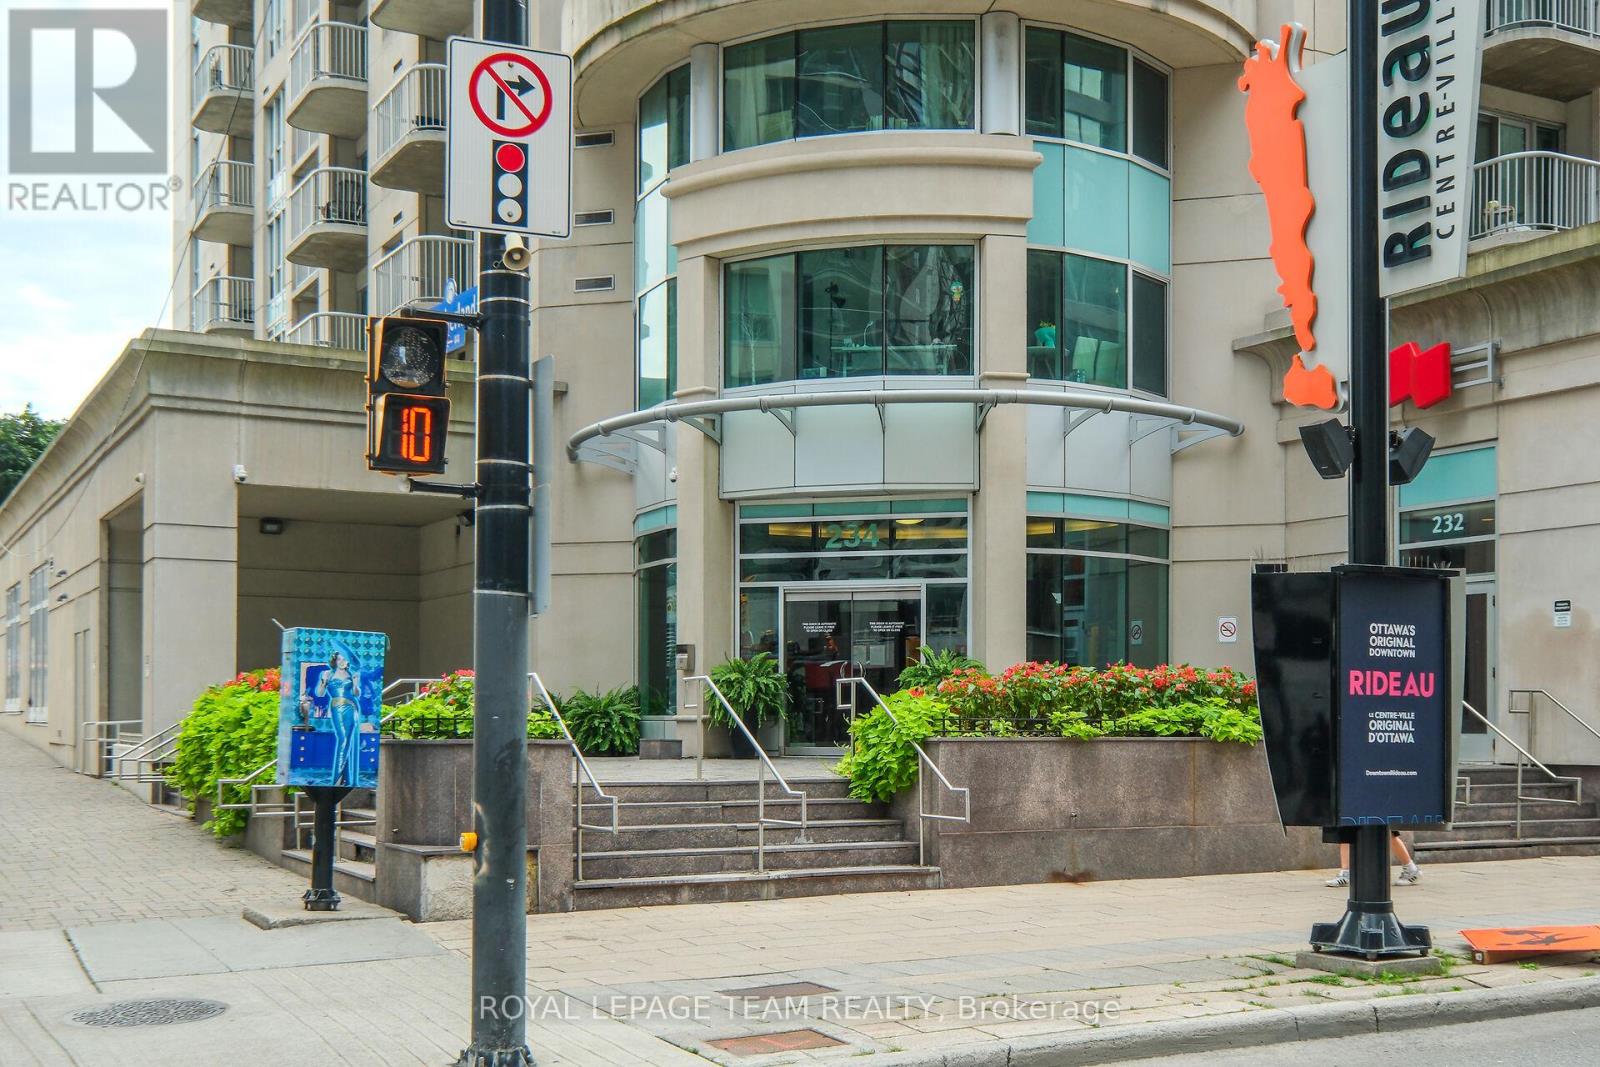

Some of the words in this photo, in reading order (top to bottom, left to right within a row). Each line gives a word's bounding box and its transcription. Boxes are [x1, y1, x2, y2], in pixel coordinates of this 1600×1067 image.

[1436, 0, 1455, 240] CENTRE-VILL
[402, 407, 431, 462] 10
[1432, 512, 1465, 534] 232
[825, 522, 880, 549] 234
[1369, 622, 1416, 636] OTTAWA'S
[1369, 635, 1416, 649] ORIGINAL
[1369, 648, 1416, 658] DOWNTOWN
[1349, 670, 1435, 698] RIDEAU
[1374, 711, 1416, 720] CENTRE-VILLE
[1368, 719, 1416, 732] ORIGINAL
[1368, 732, 1416, 744] D'OTTAWA
